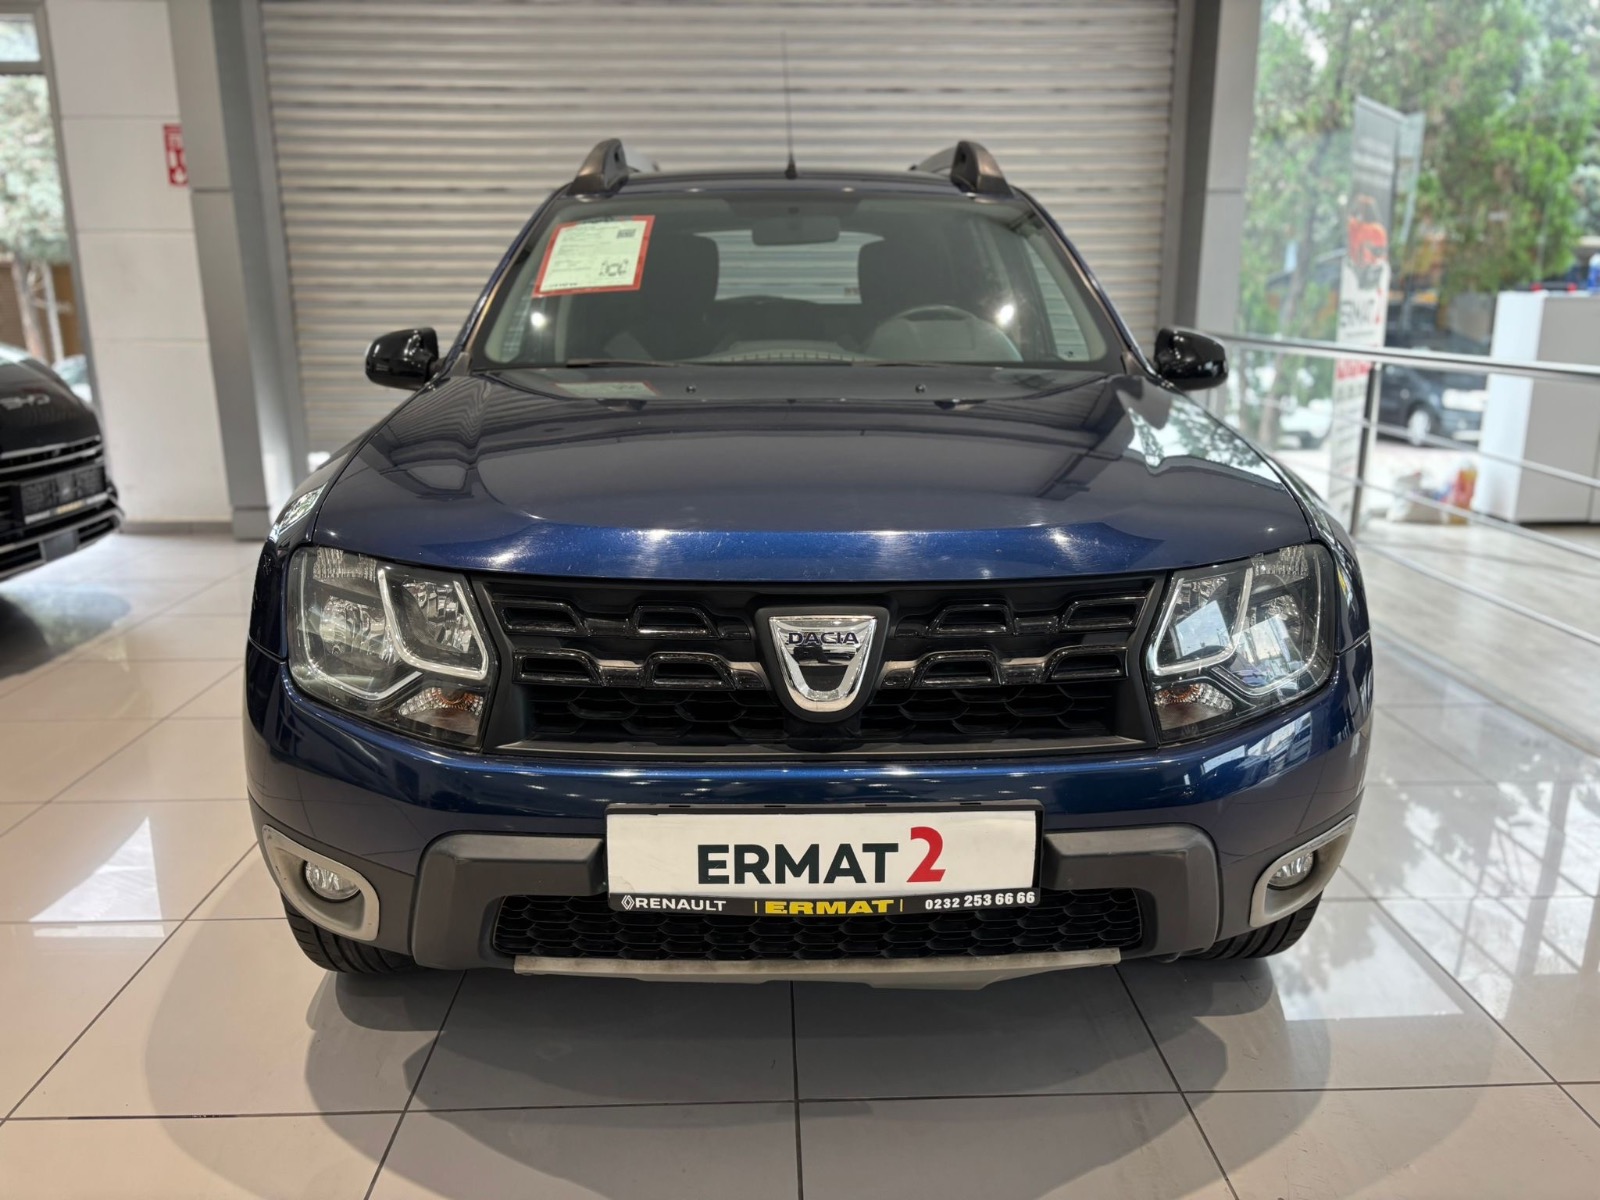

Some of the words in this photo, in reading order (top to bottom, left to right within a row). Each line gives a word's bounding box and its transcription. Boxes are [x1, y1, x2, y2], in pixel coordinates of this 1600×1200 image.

[788, 632, 859, 645] DACIA
[698, 843, 899, 884] ERMAT
[907, 826, 946, 883] 2
[636, 897, 727, 912] RENAULT
[765, 900, 894, 914] ERMAT
[925, 898, 960, 910] 0232
[964, 894, 992, 907] 253
[995, 892, 1014, 905] 66
[1016, 891, 1036, 904] 66
